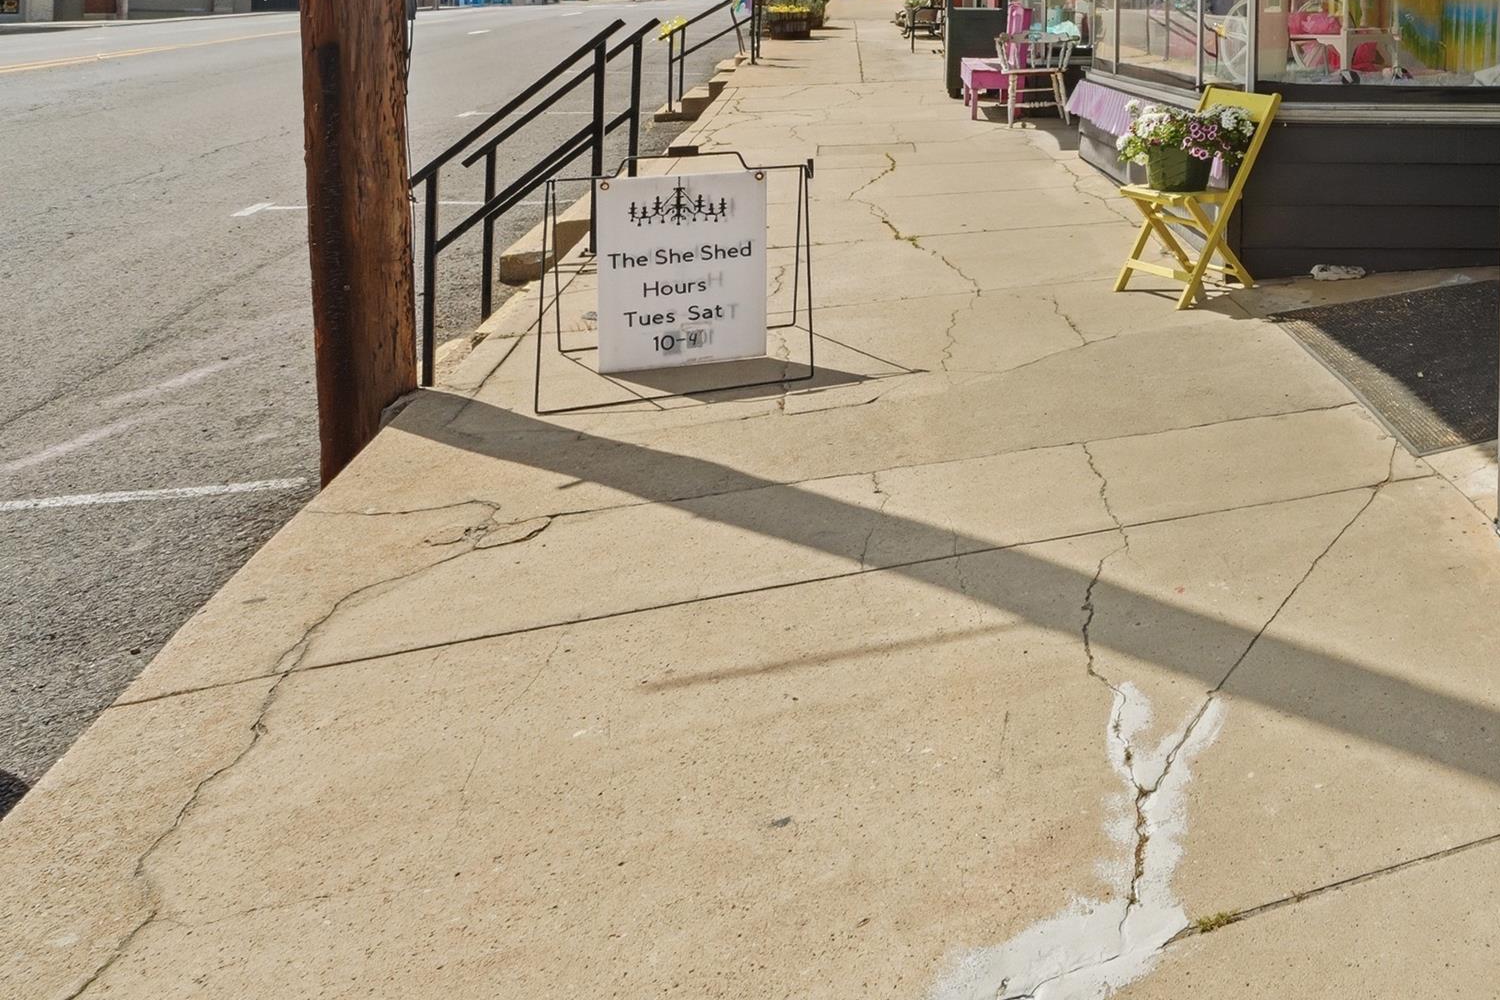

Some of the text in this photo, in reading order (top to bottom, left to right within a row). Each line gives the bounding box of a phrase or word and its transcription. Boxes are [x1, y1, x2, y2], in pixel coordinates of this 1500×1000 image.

[607, 240, 752, 269] The She Shed
[643, 280, 707, 298] Hours
[624, 304, 723, 327] Tues Sat
